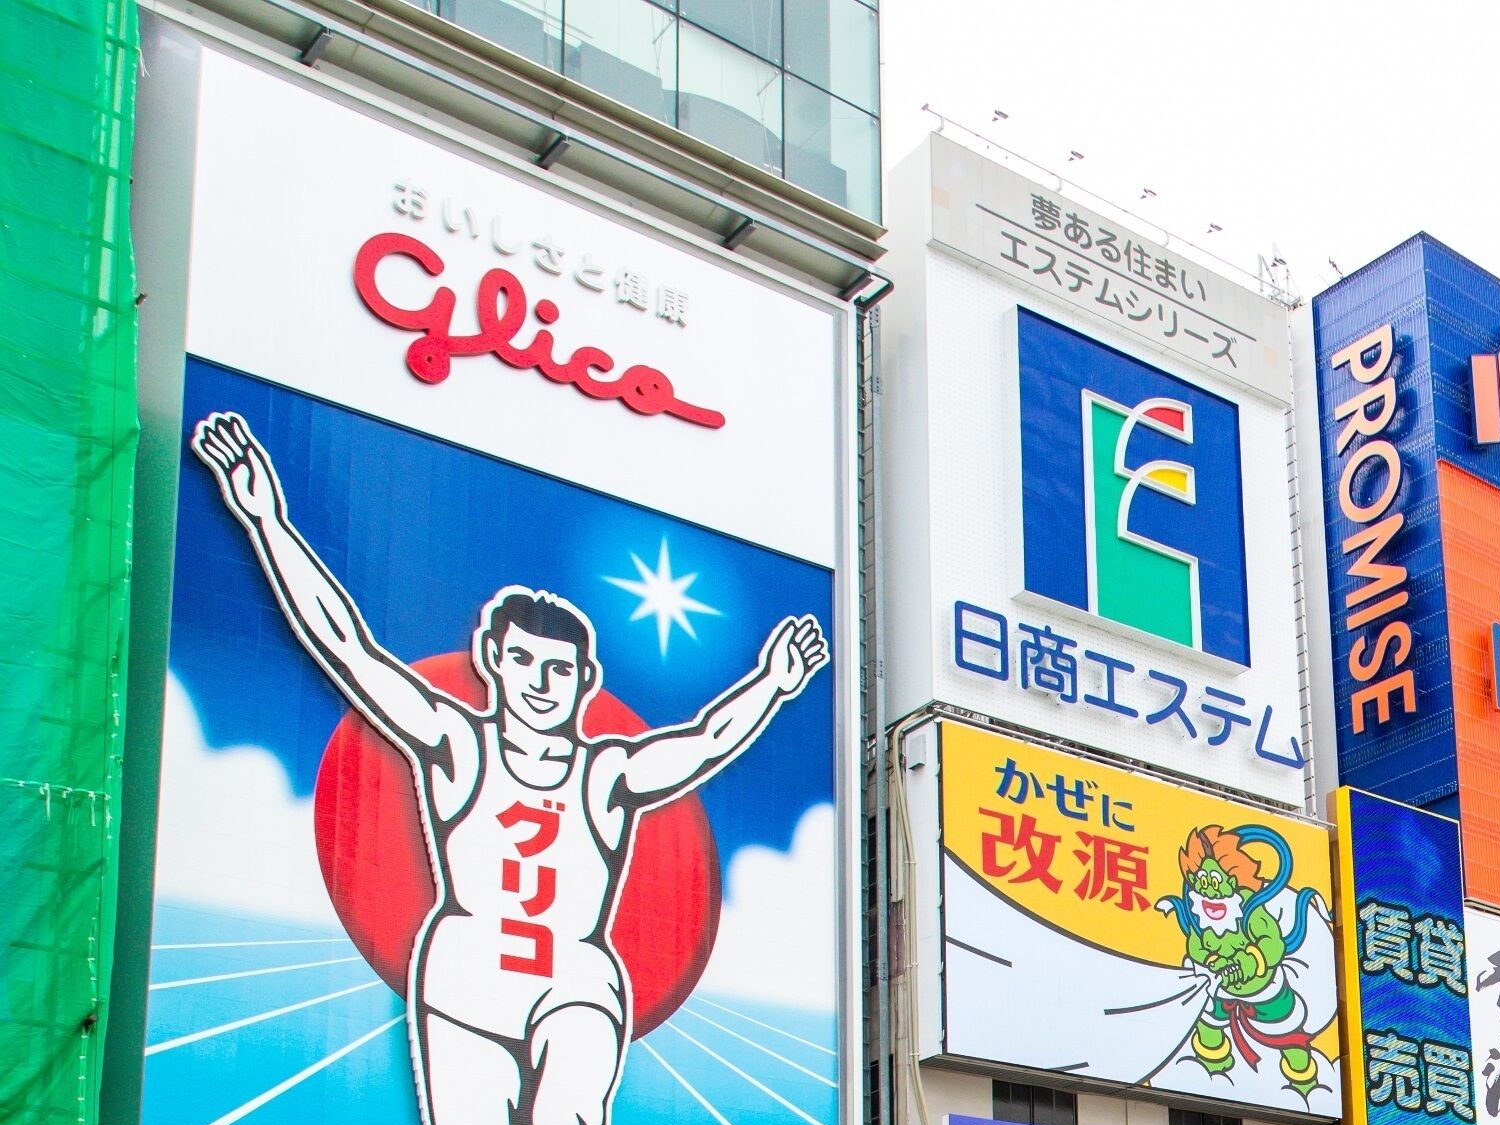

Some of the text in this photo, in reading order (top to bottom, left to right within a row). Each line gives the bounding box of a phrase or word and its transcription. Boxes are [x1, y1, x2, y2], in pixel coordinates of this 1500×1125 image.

[394, 178, 690, 329] おいしさと健康
[1000, 231, 1239, 368] エステムシリーズ
[1031, 194, 1206, 302] 夢ある住まい
[1333, 323, 1417, 734] PROMISE
[954, 600, 1305, 770] 日商エステム
[995, 757, 1135, 832] かぜに
[496, 799, 566, 979] グリコ
[979, 807, 1151, 912] 改源
[1358, 901, 1467, 995] 賃貸
[1365, 1029, 1476, 1121] 売買
